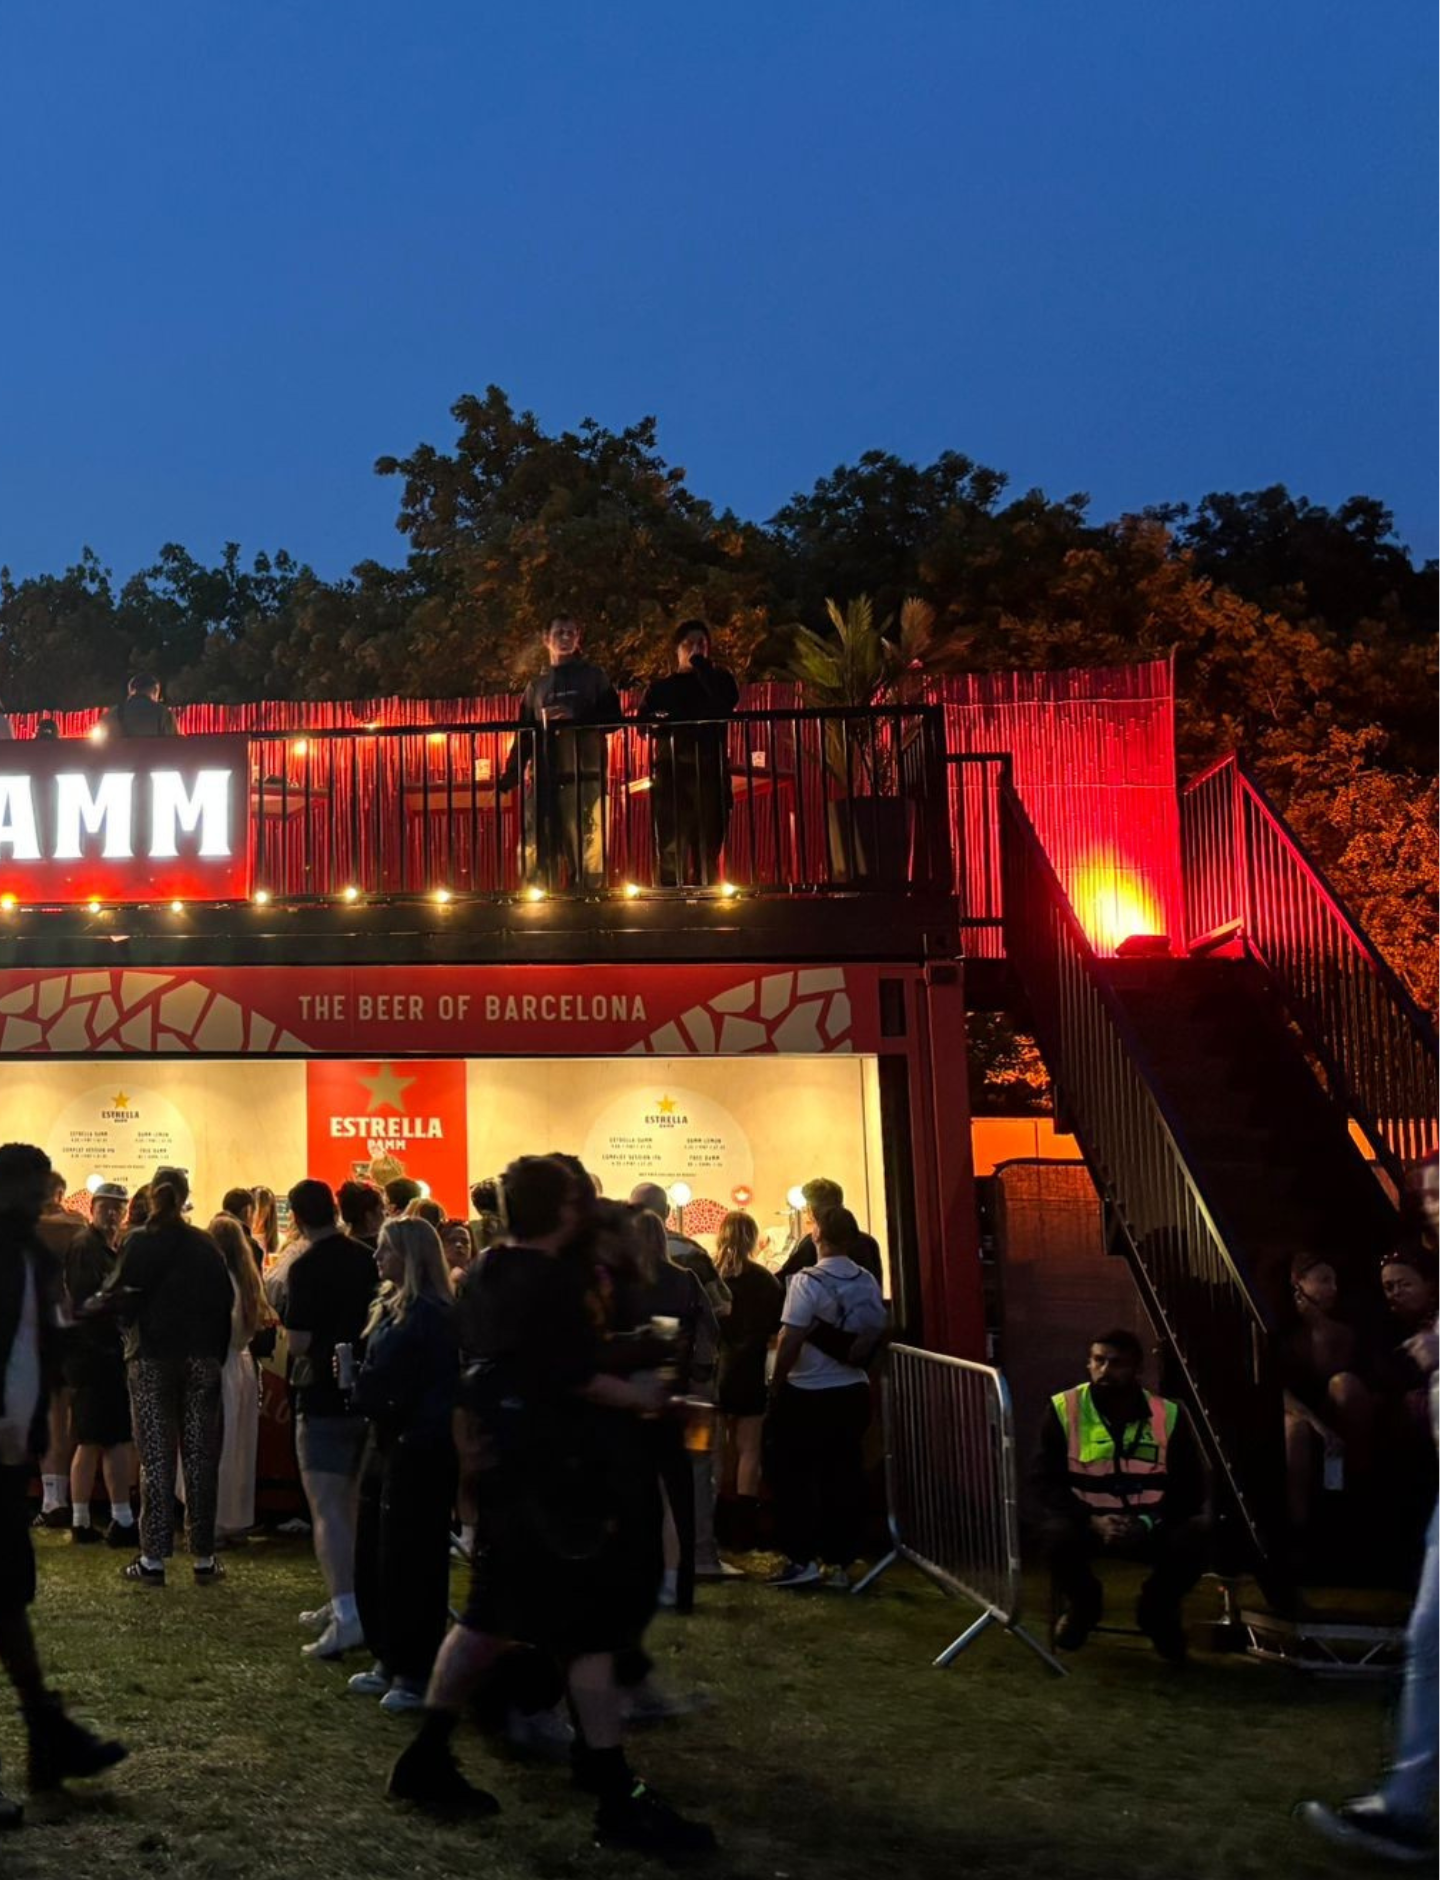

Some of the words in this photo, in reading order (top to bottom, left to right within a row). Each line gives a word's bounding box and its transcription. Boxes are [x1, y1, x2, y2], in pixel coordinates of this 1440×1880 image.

[299, 996, 345, 1020] THE
[360, 996, 424, 1020] BEER
[439, 996, 471, 1020] OF
[486, 996, 646, 1020] BARCELONA
[329, 1116, 444, 1138] ESTRELLA
[645, 1115, 688, 1124] ESTRELLA
